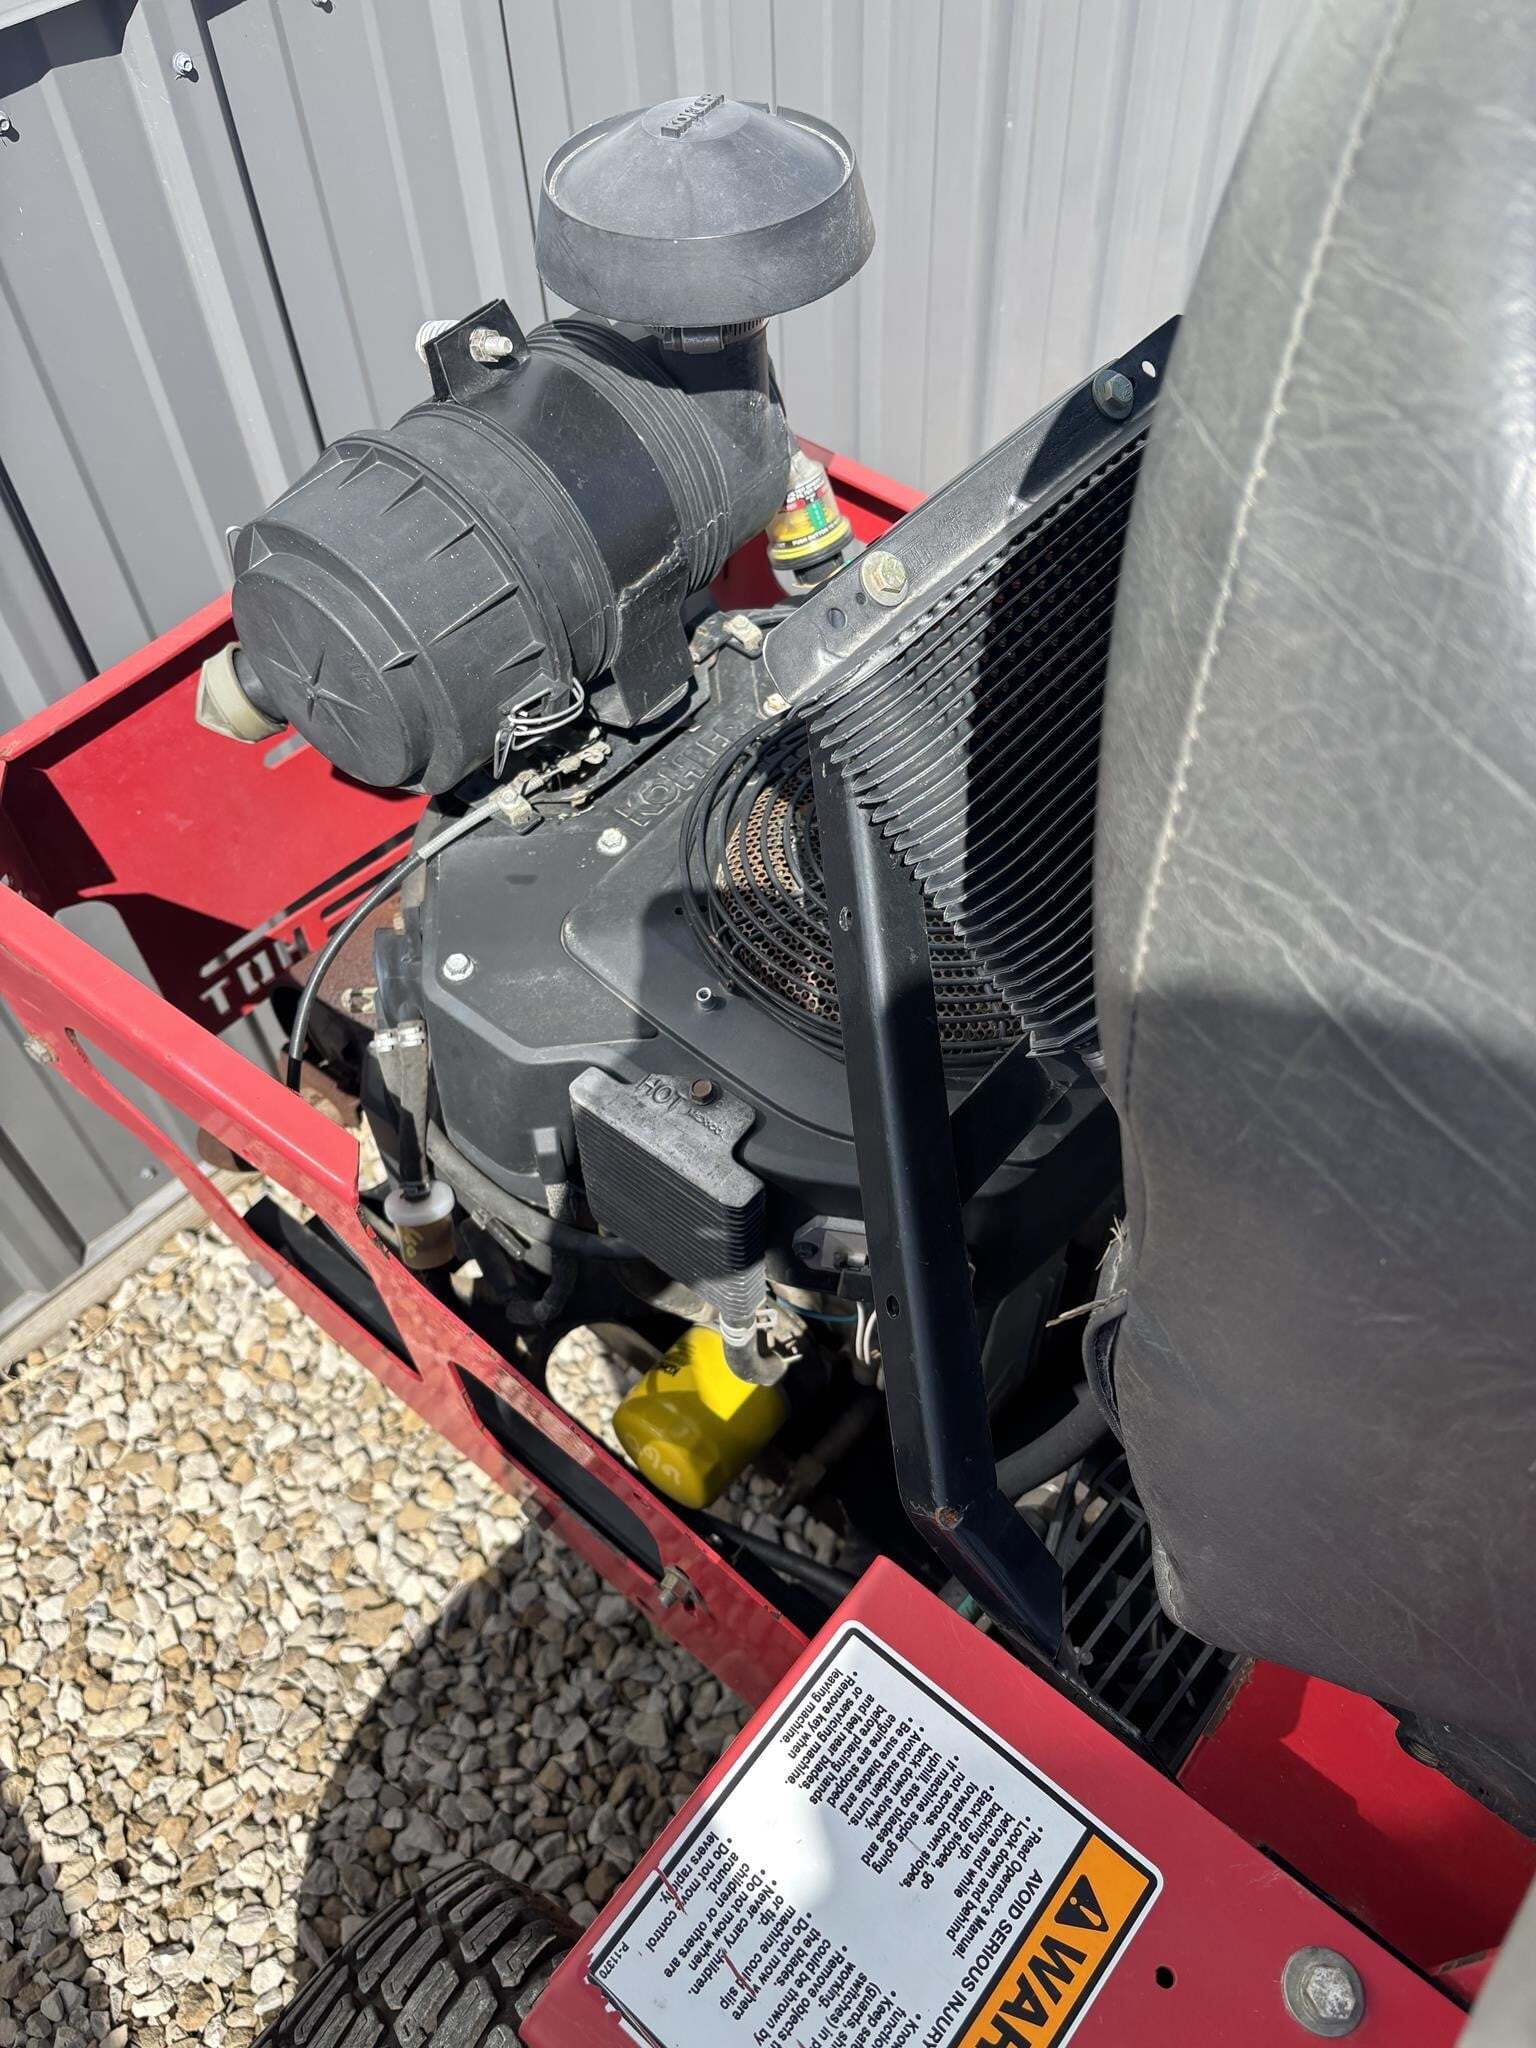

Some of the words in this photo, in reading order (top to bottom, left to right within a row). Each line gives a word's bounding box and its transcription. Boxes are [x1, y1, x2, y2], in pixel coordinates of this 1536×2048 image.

[635, 1073, 688, 1112] HOT
[810, 1667, 844, 1704] leaving
[821, 1674, 857, 1715] Remove
[851, 1686, 863, 1701] or
[816, 1697, 855, 1744] servicing
[857, 1693, 875, 1717] and
[858, 1703, 888, 1737] before
[779, 1701, 817, 1744] machine.
[807, 1712, 828, 1734] key
[842, 1712, 864, 1735] feet
[868, 1713, 897, 1749] engine
[894, 1720, 912, 1738] Be
[787, 1731, 812, 1760] when
[826, 1731, 848, 1758] near
[830, 1732, 863, 1774] placing
[856, 1746, 873, 1766] are
[878, 1735, 899, 1761] sure
[895, 1729, 922, 1764] Avoid
[908, 1741, 934, 1770] back
[784, 1740, 823, 1785] machine.
[798, 1753, 834, 1790] blades,
[853, 1757, 885, 1794] blades
[869, 1758, 901, 1799] sudden
[914, 1751, 943, 1785] uphill,
[945, 1759, 958, 1773] If
[808, 1770, 839, 1805] hands
[825, 1763, 860, 1809] stopped
[888, 1766, 914, 1797] down
[899, 1782, 921, 1809] stop
[915, 1767, 950, 1813] machine
[948, 1770, 966, 1793] not
[838, 1791, 858, 1818] and
[847, 1796, 876, 1827] turns.
[863, 1794, 894, 1831] slowly.
[921, 1789, 954, 1827] across.
[946, 1781, 980, 1825] forward
[967, 1789, 994, 1819] Back
[875, 1805, 907, 1844] blades
[894, 1810, 920, 1843] stops
[926, 1820, 952, 1852] down
[957, 1815, 974, 1833] up
[967, 1800, 1004, 1846] backing
[986, 1811, 1017, 1848] before
[1003, 1820, 1030, 1851] Look
[689, 1830, 720, 1866] levers
[712, 1841, 730, 1861] Do
[860, 1840, 880, 1868] and
[871, 1839, 899, 1875] going
[930, 1831, 963, 1869] slopes,
[956, 1842, 975, 1860] up.
[972, 1845, 992, 1872] and
[984, 1847, 1010, 1880] down
[1016, 1830, 1042, 1864] Read
[697, 1858, 716, 1882] not
[705, 1851, 739, 1895] around.
[714, 1862, 750, 1909] children
[745, 1873, 764, 1892] Do
[898, 1849, 931, 1888] slopes,
[920, 1870, 935, 1890] go
[953, 1867, 978, 1899] while
[730, 1890, 749, 1914] not
[745, 1884, 775, 1920] Never
[771, 1895, 785, 1911] or
[970, 1877, 990, 1905] and
[1007, 1868, 1044, 1921] AVOID
[644, 1909, 678, 1954] control
[705, 1906, 718, 1924] or
[711, 1909, 736, 1942] mow
[757, 1908, 777, 1927] tip.
[759, 1904, 797, 1955] machine
[791, 1916, 810, 1937] Do
[945, 1898, 979, 1943] behind
[677, 1920, 708, 1959] others
[722, 1916, 749, 1950] carry
[776, 1933, 796, 1958] not
[802, 1927, 822, 1949] the
[951, 1914, 988, 1960] Manual.
[598, 1940, 630, 1980] P-11370
[663, 1956, 681, 1978] are
[687, 1938, 716, 1972] when
[757, 1953, 782, 1986] mow
[773, 1945, 809, 1987] blades.
[804, 1938, 832, 1976] could
[960, 1918, 1013, 1993] SERIOUS
[793, 1970, 812, 1989] be
[807, 1949, 846, 1999] Remove
[817, 1961, 857, 2010] working.
[719, 1985, 739, 2010] slip
[765, 1987, 800, 2030] thrown
[824, 1971, 868, 2030] switches)
[841, 1981, 883, 2030] (guards,
[866, 1995, 895, 2029] Keep
[777, 1996, 811, 2042] objects
[817, 2025, 834, 2042] in
[752, 2027, 773, 2047] by
